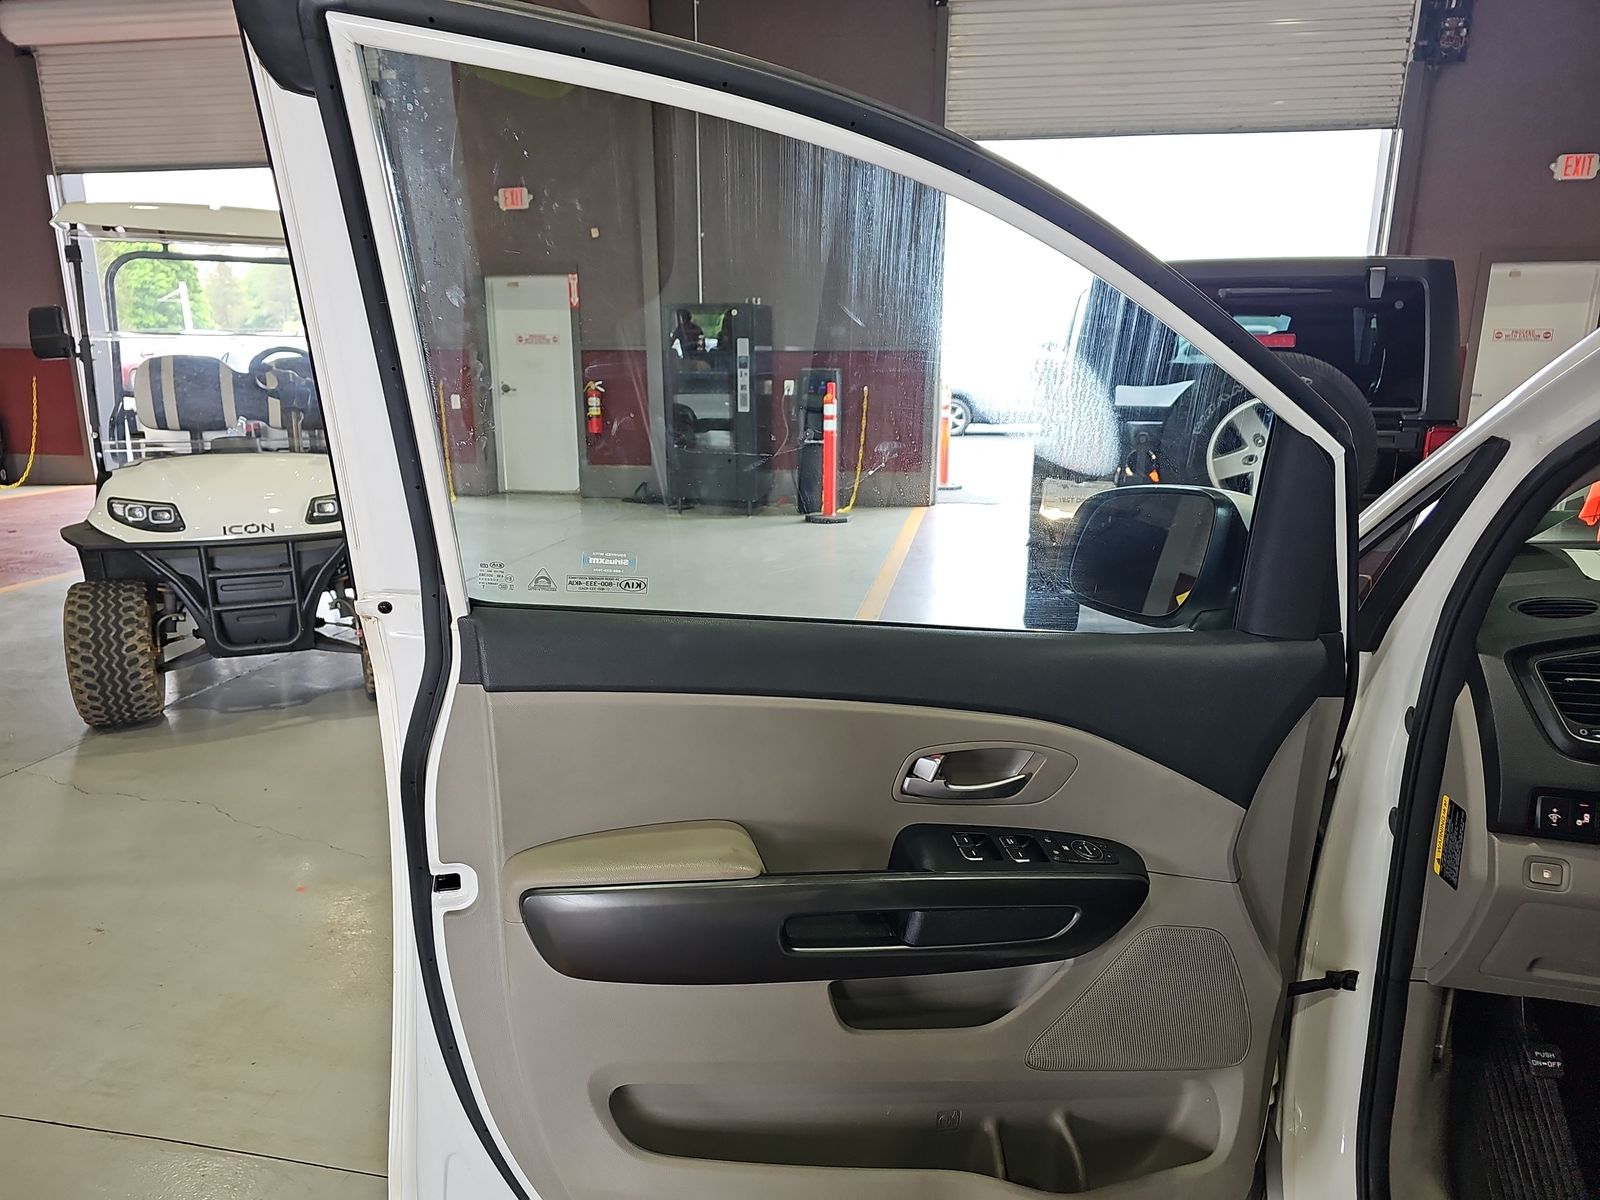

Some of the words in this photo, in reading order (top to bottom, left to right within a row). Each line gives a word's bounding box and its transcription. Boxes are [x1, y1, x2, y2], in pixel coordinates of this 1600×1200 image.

[1564, 155, 1595, 176] EXIT
[222, 522, 275, 536] ICON
[1534, 1051, 1556, 1059] PUSH
[1531, 1060, 1562, 1068] ON-OFF
